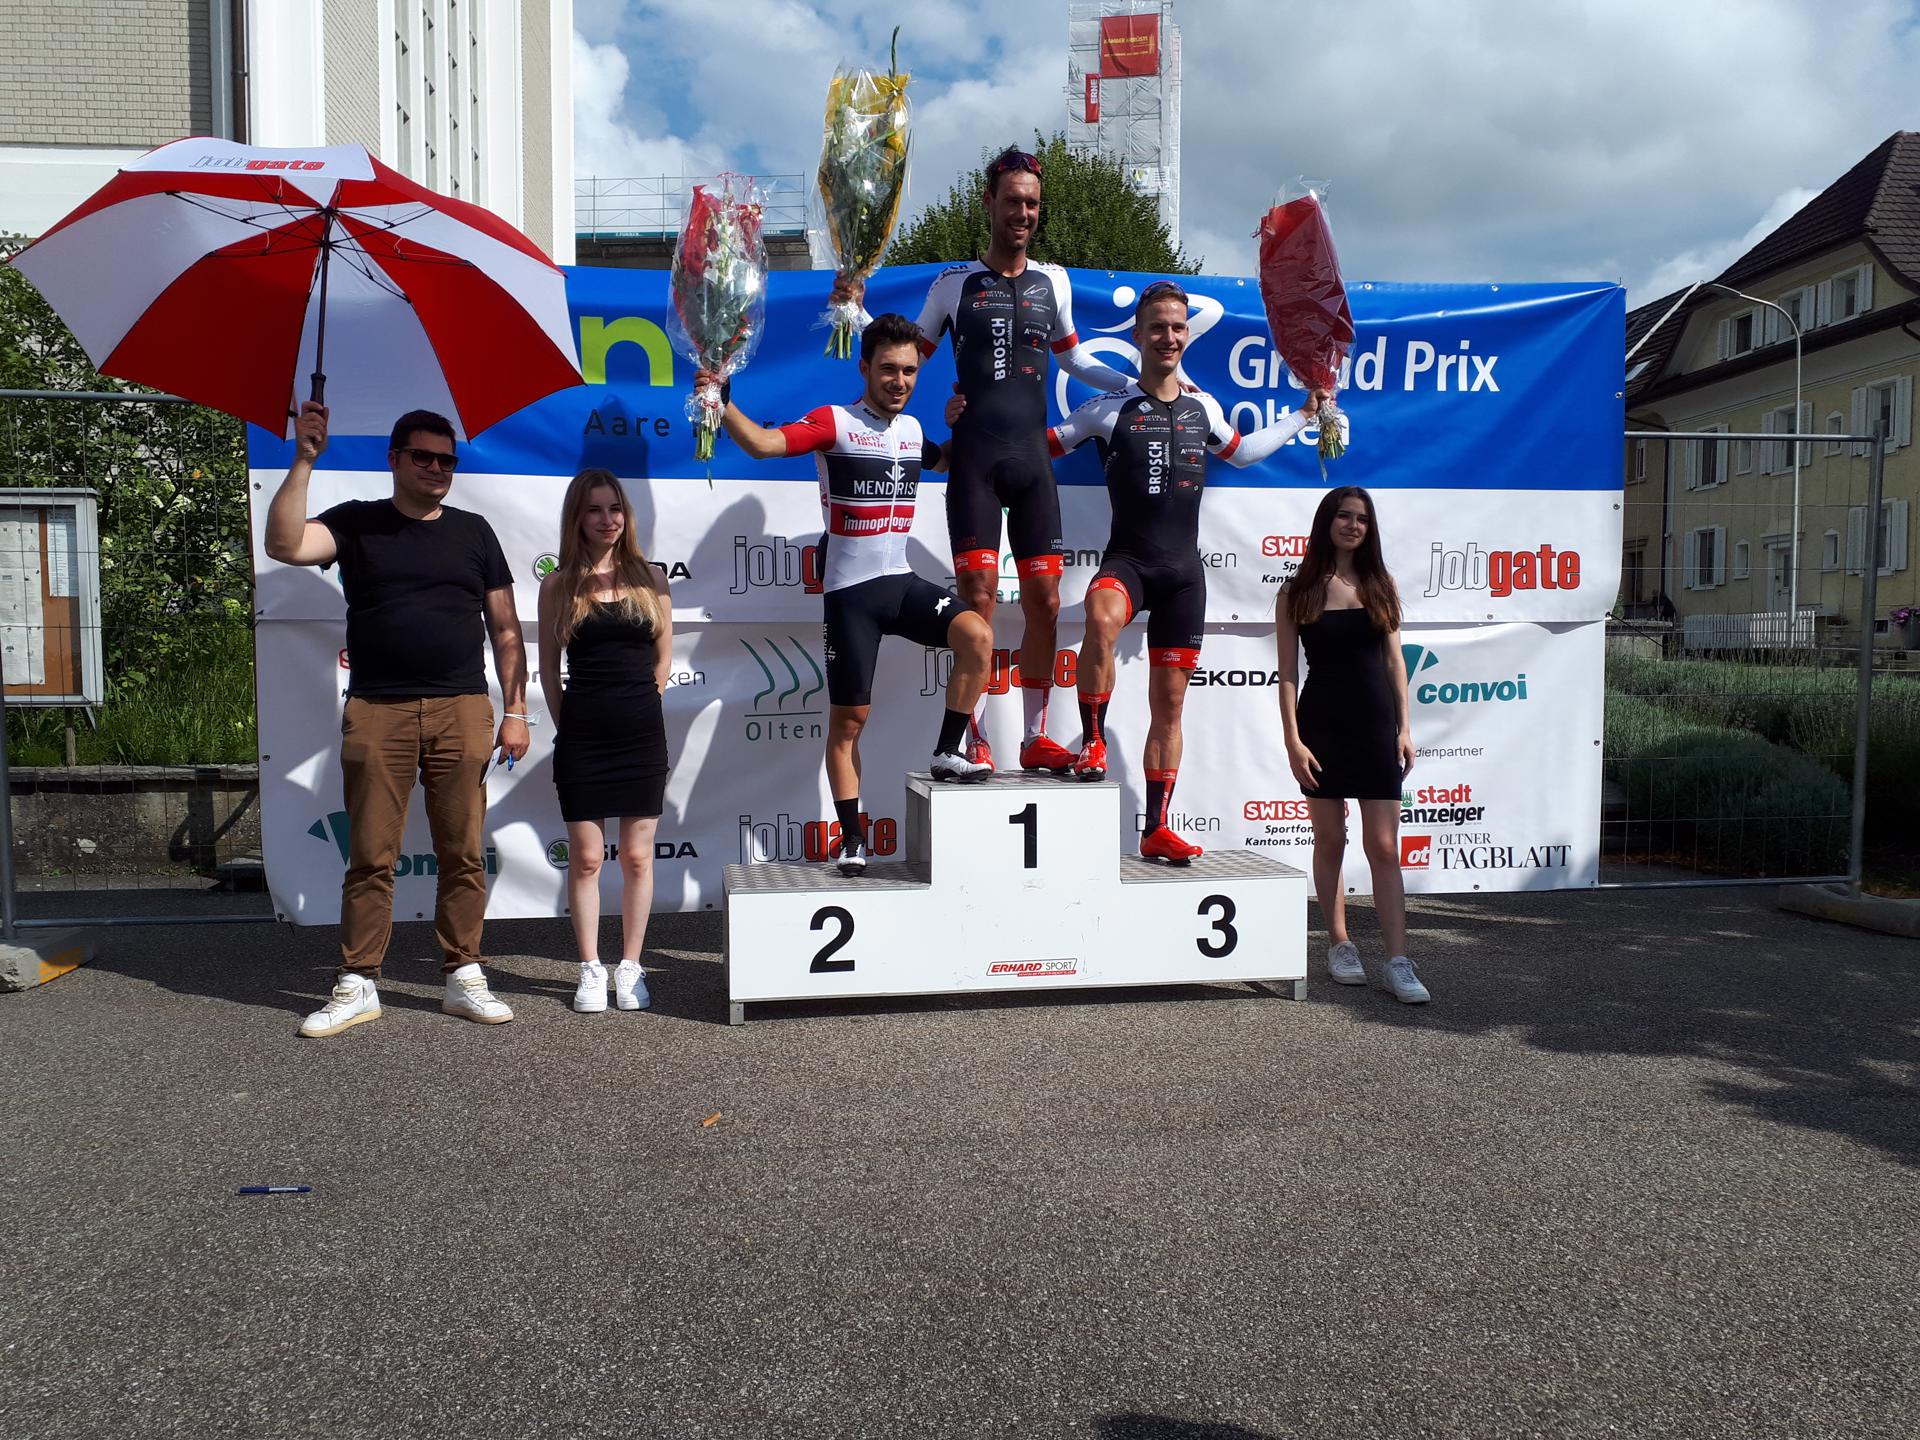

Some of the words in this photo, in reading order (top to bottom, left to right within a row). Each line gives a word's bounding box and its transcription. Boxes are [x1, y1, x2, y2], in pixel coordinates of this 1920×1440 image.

[991, 317, 1006, 381] BROSCH
[1229, 336, 1387, 391] Grd
[1404, 340, 1500, 392] Prix
[584, 409, 670, 437] Aare
[1148, 441, 1162, 494] BROSCH
[729, 535, 824, 595] jobg
[1424, 543, 1581, 597] jobgate
[1416, 674, 1528, 705] convoi
[745, 721, 821, 742] Olten
[1415, 746, 1484, 759] dienpartner
[1417, 784, 1472, 804] stadt
[1400, 803, 1485, 826] anzeiger
[1009, 802, 1038, 869] 1
[1245, 837, 1291, 847] Kantons
[1439, 833, 1491, 846] OLTNER
[1407, 846, 1430, 865] ot
[1437, 845, 1571, 870] TAGBLATT
[809, 906, 855, 973] 2
[1196, 894, 1238, 958] 3
[991, 963, 1043, 973] ERHARD
[1045, 961, 1073, 971] SPORT
